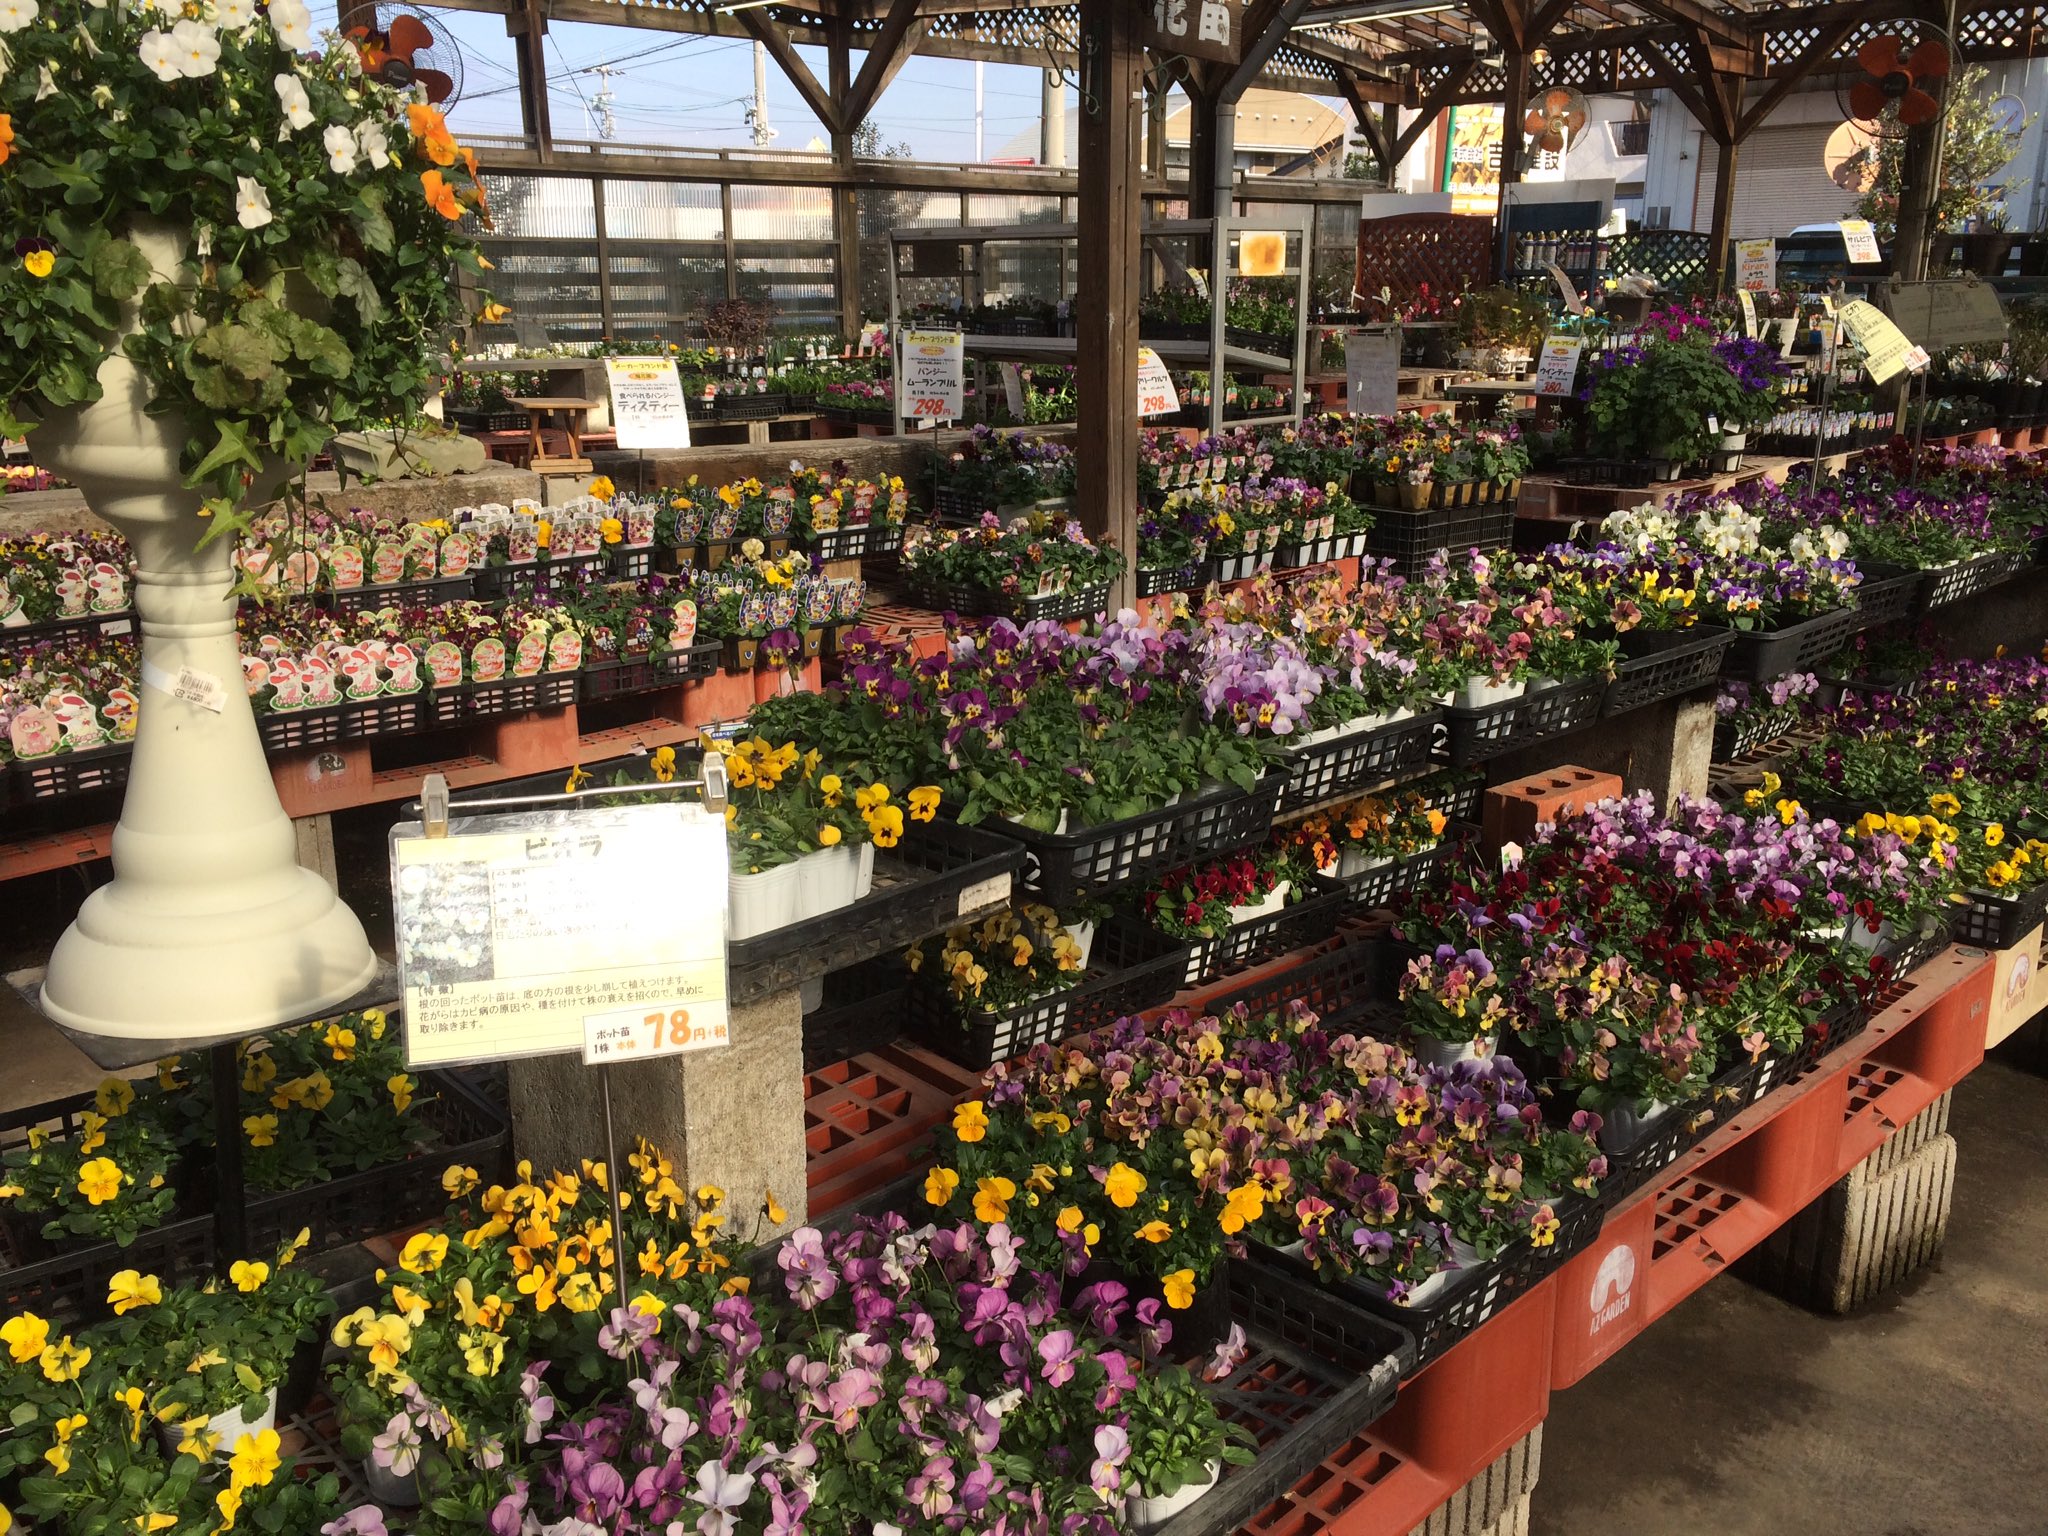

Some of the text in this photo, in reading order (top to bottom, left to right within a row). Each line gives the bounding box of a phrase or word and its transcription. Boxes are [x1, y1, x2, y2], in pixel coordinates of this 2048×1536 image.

[1846, 235, 1872, 243] サルビア
[917, 367, 947, 376] パンジー
[619, 392, 676, 400] 食べられるパンジー
[617, 401, 680, 413] ティスティー
[525, 833, 603, 861] ビオラ
[419, 1022, 485, 1035] 取り除きます。
[595, 1027, 631, 1039] ポット苗
[593, 1043, 610, 1055] 1株
[1600, 1291, 1631, 1327] GARDEN
